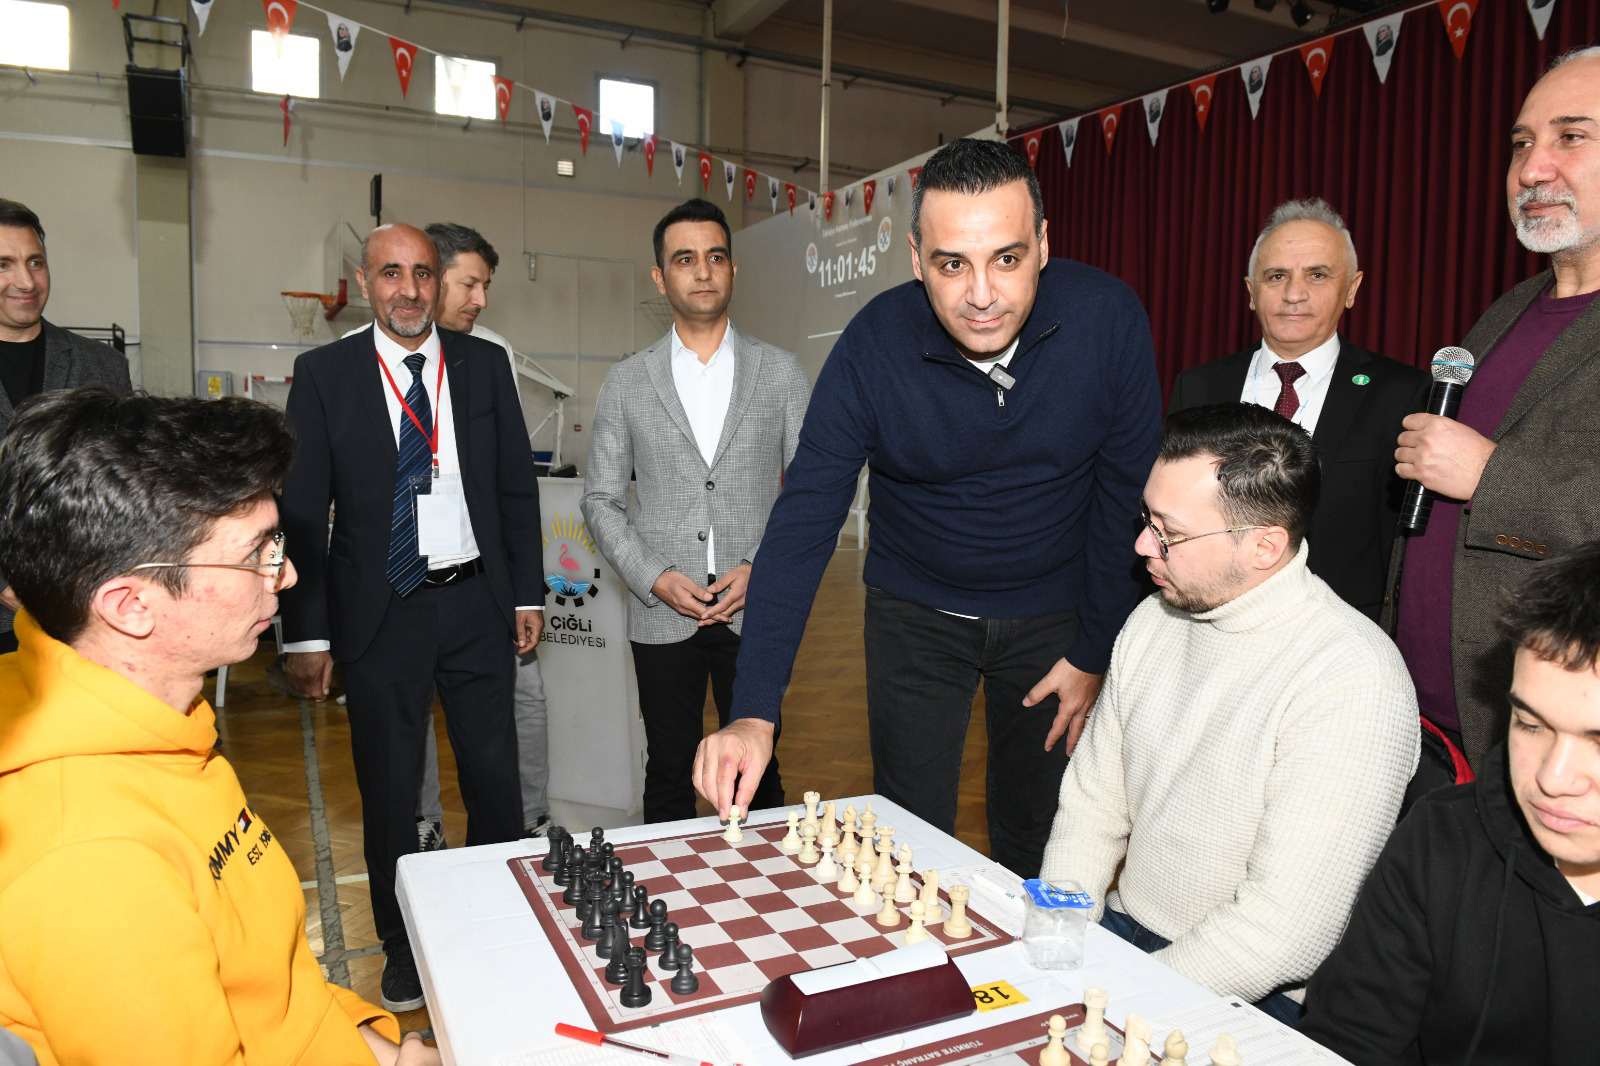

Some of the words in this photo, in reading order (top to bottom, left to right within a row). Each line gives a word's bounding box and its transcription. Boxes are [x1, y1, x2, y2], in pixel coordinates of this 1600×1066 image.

[818, 244, 877, 288] 11:01:45
[972, 986, 1011, 1005] 18
[941, 1039, 984, 1057] TÜRKİYE
